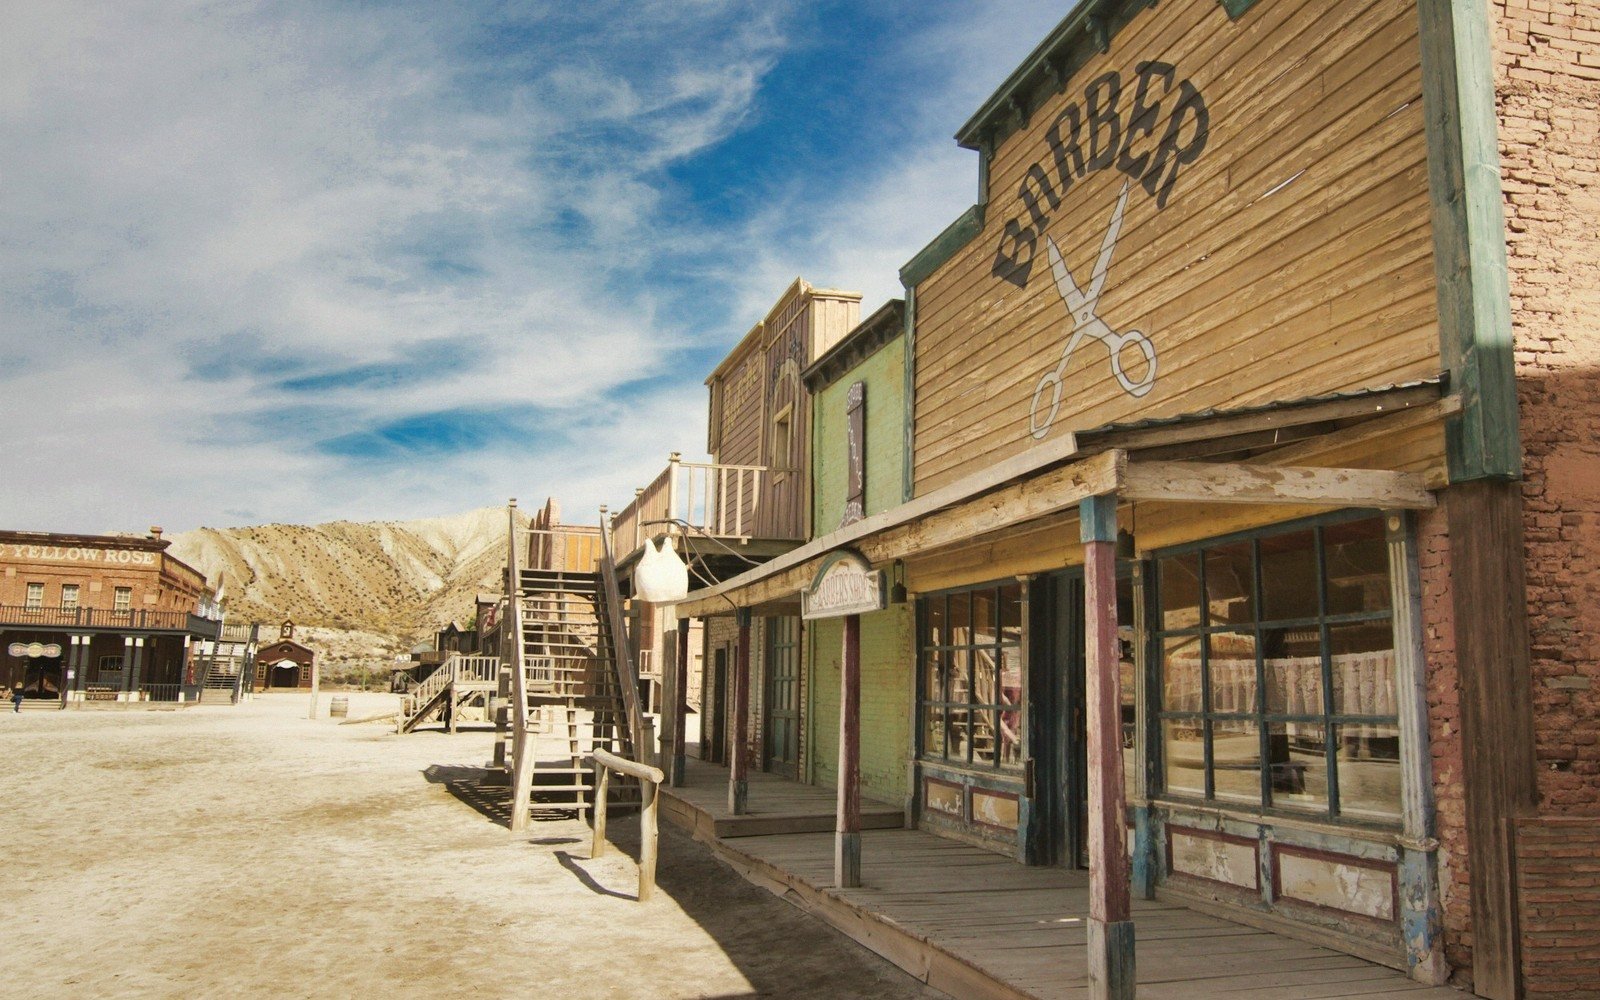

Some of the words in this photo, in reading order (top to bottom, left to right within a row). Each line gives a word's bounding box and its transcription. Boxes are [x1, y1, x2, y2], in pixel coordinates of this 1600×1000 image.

[992, 61, 1209, 290] BARBER
[14, 546, 99, 562] YELLOW
[105, 550, 155, 565] ROSE
